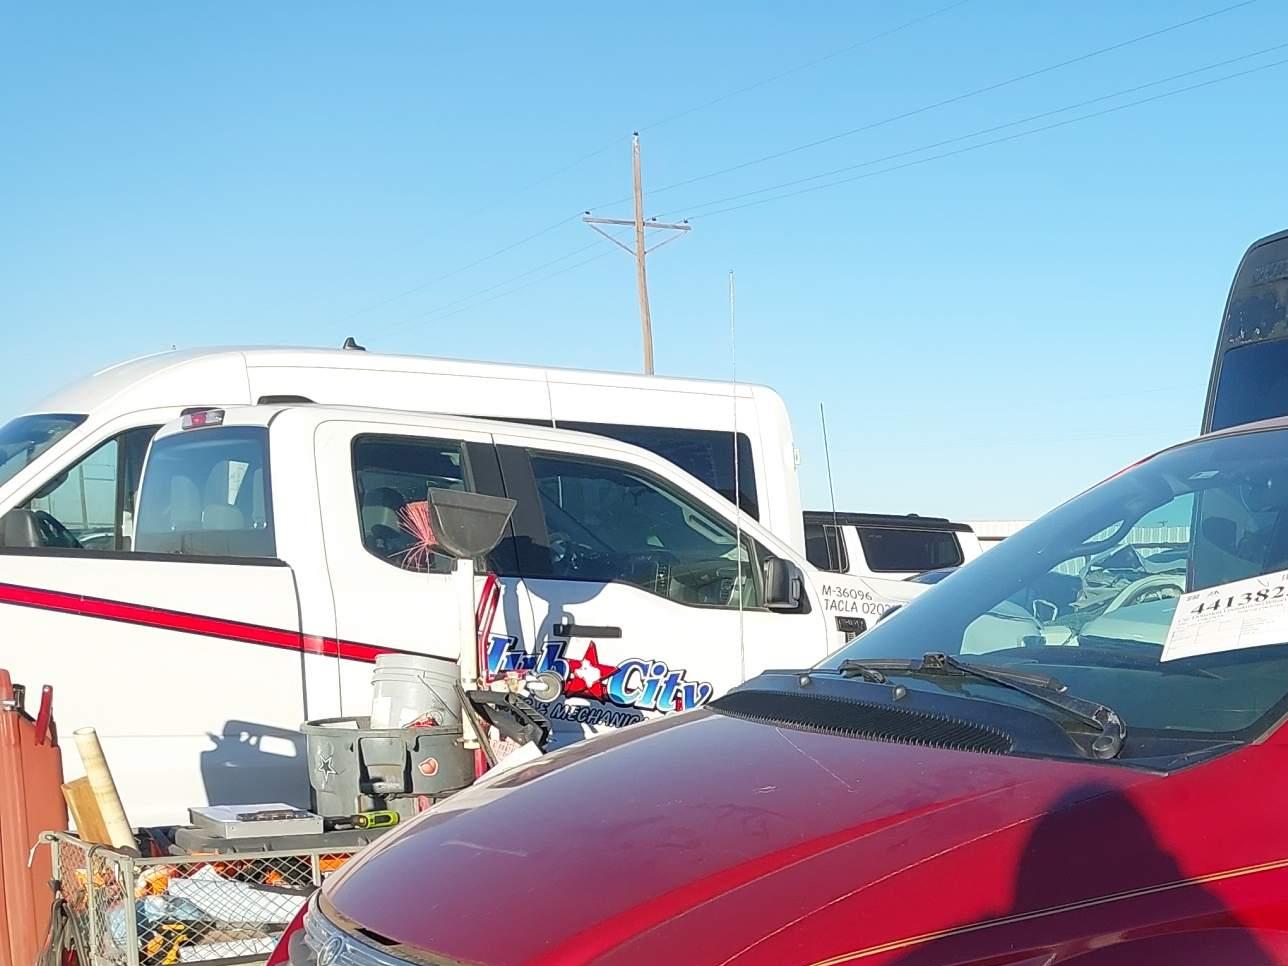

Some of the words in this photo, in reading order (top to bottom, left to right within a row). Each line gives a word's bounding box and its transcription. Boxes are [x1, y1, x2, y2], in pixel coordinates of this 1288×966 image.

[822, 584, 872, 601] M-36096
[824, 598, 858, 613] TACLA
[607, 658, 714, 714] City
[550, 702, 648, 728] MECHANIC
